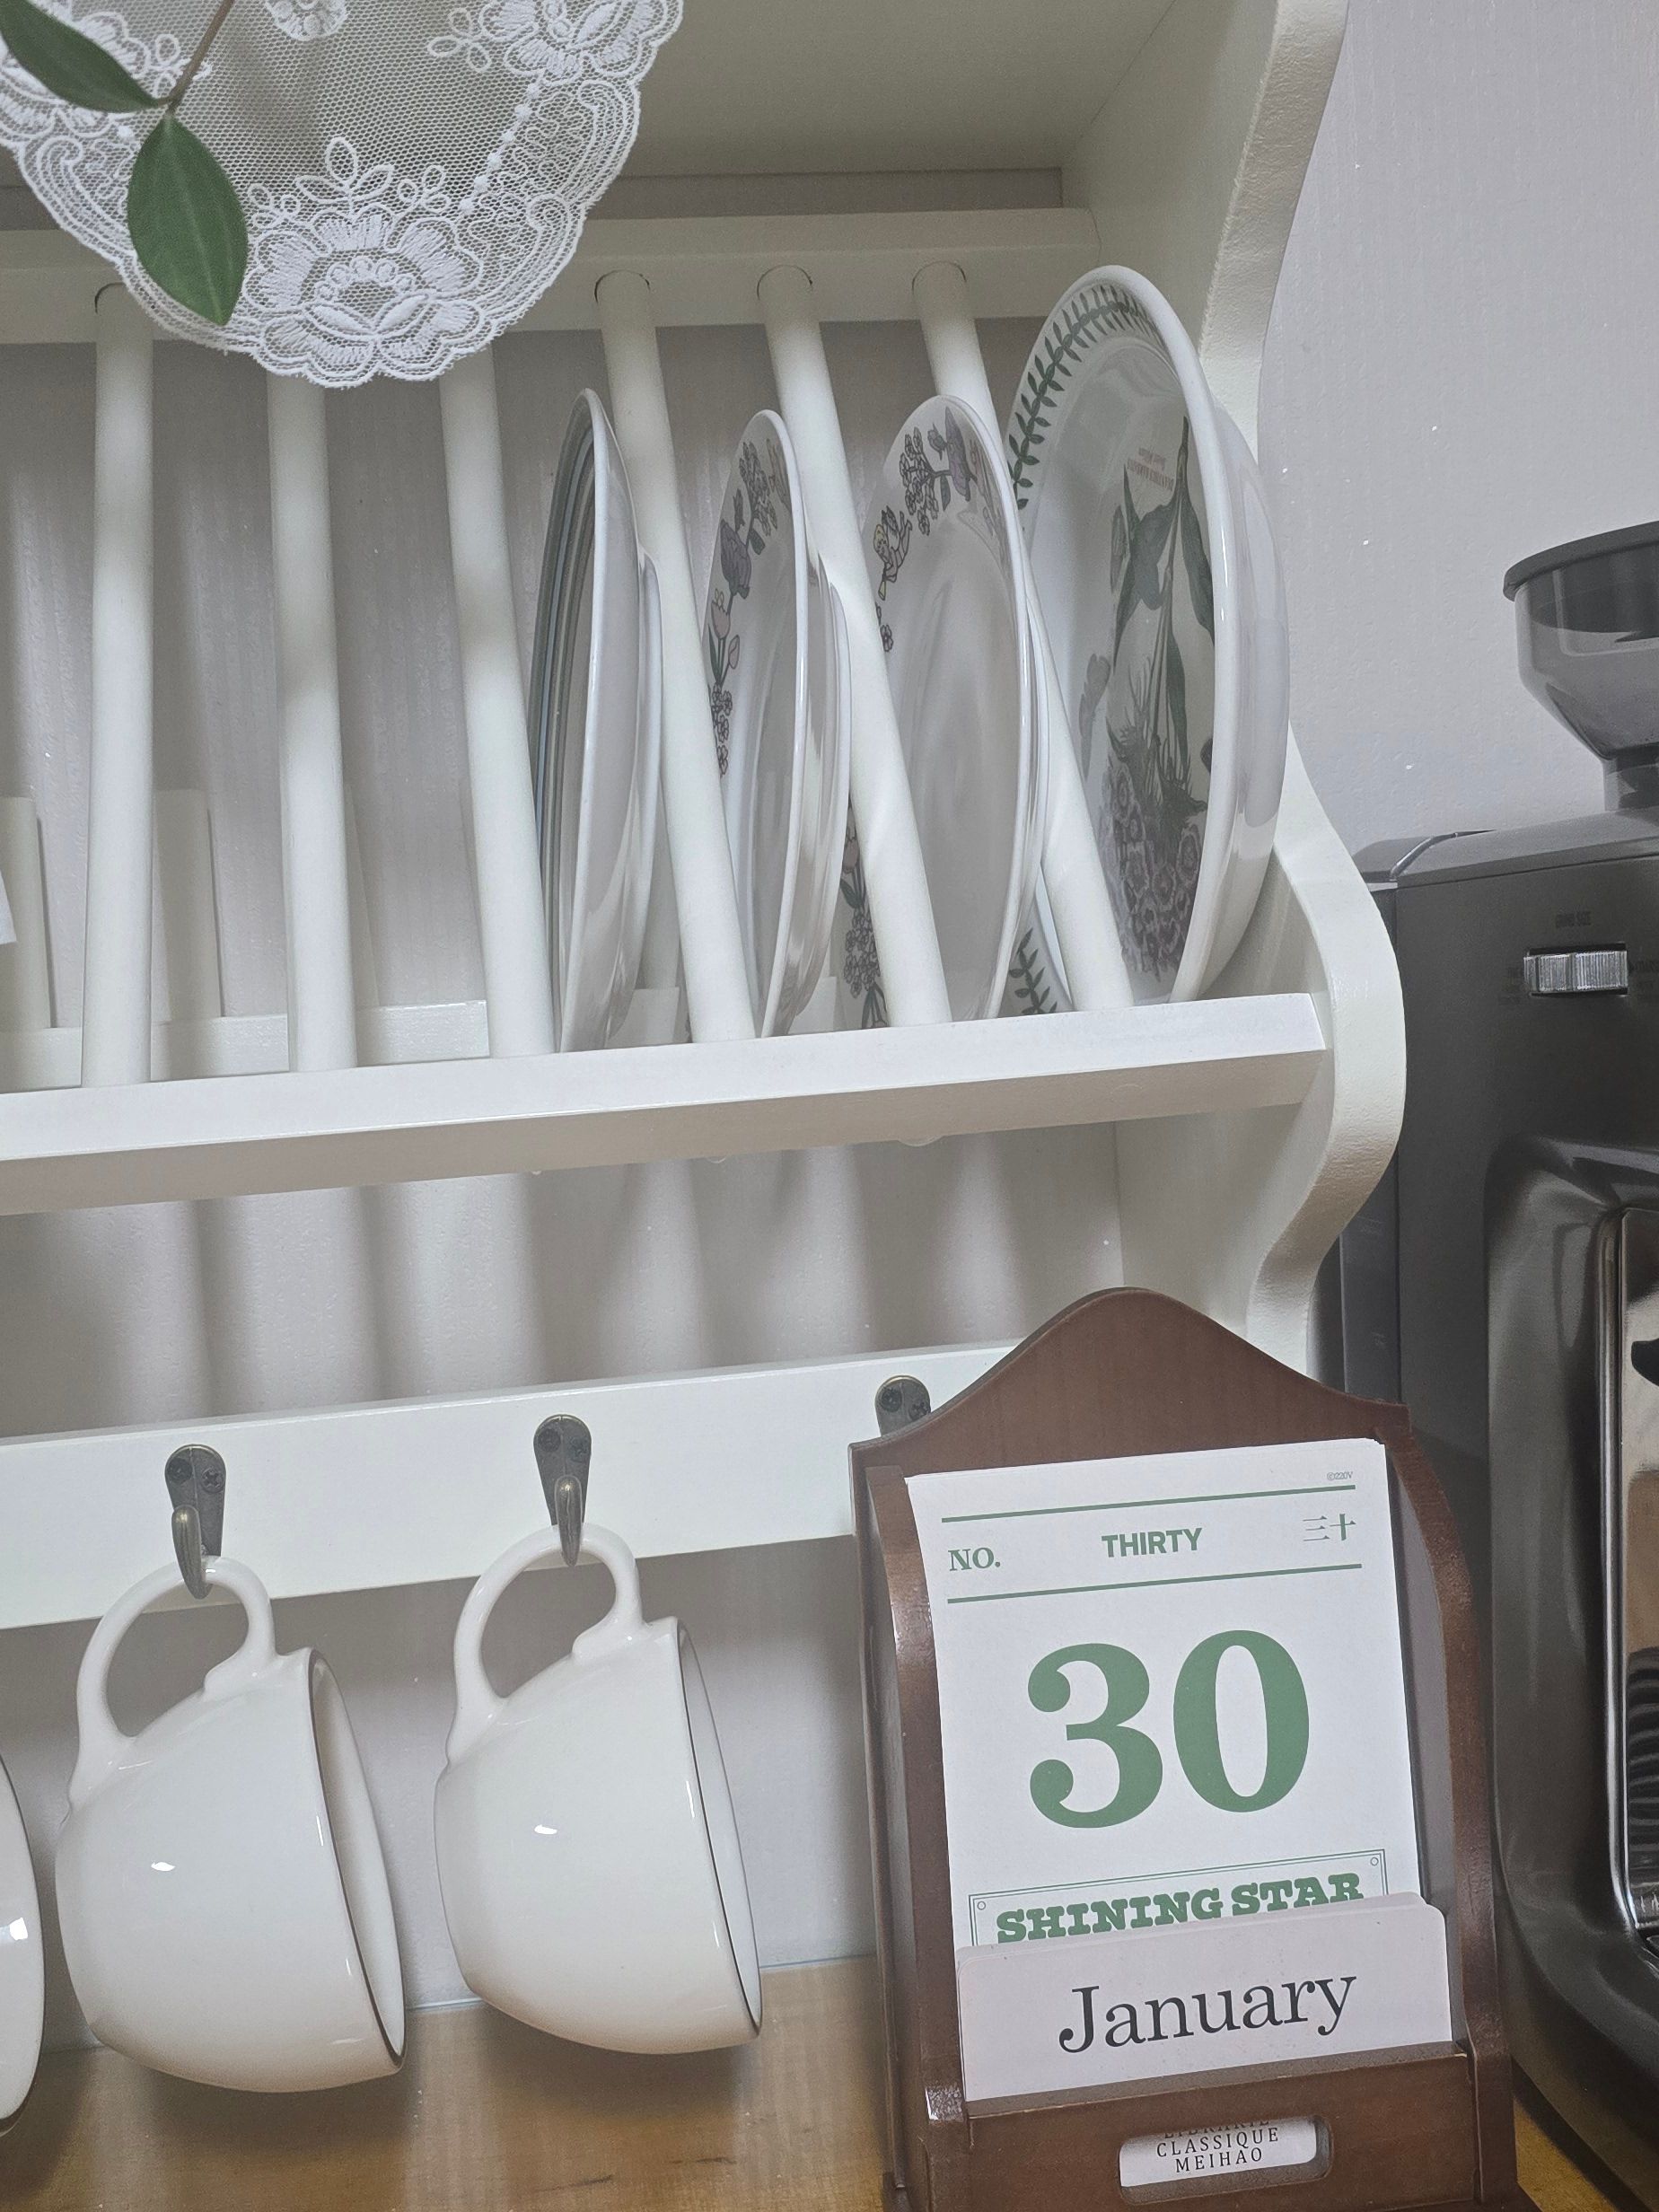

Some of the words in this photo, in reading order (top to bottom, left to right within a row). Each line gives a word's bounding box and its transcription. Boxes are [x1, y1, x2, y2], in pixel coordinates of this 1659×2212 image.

[1101, 1527, 1202, 1558] THIRTY
[1303, 1513, 1356, 1542] 三十
[947, 1547, 1001, 1572] NO.
[1027, 1629, 1310, 1829] 30
[996, 1887, 1224, 1944] SHINING
[1231, 1872, 1365, 1917] STAR
[1058, 1975, 1358, 2054] January
[1156, 2127, 1279, 2157] CLASSIQUE
[1175, 2146, 1263, 2173] MEIHAO
